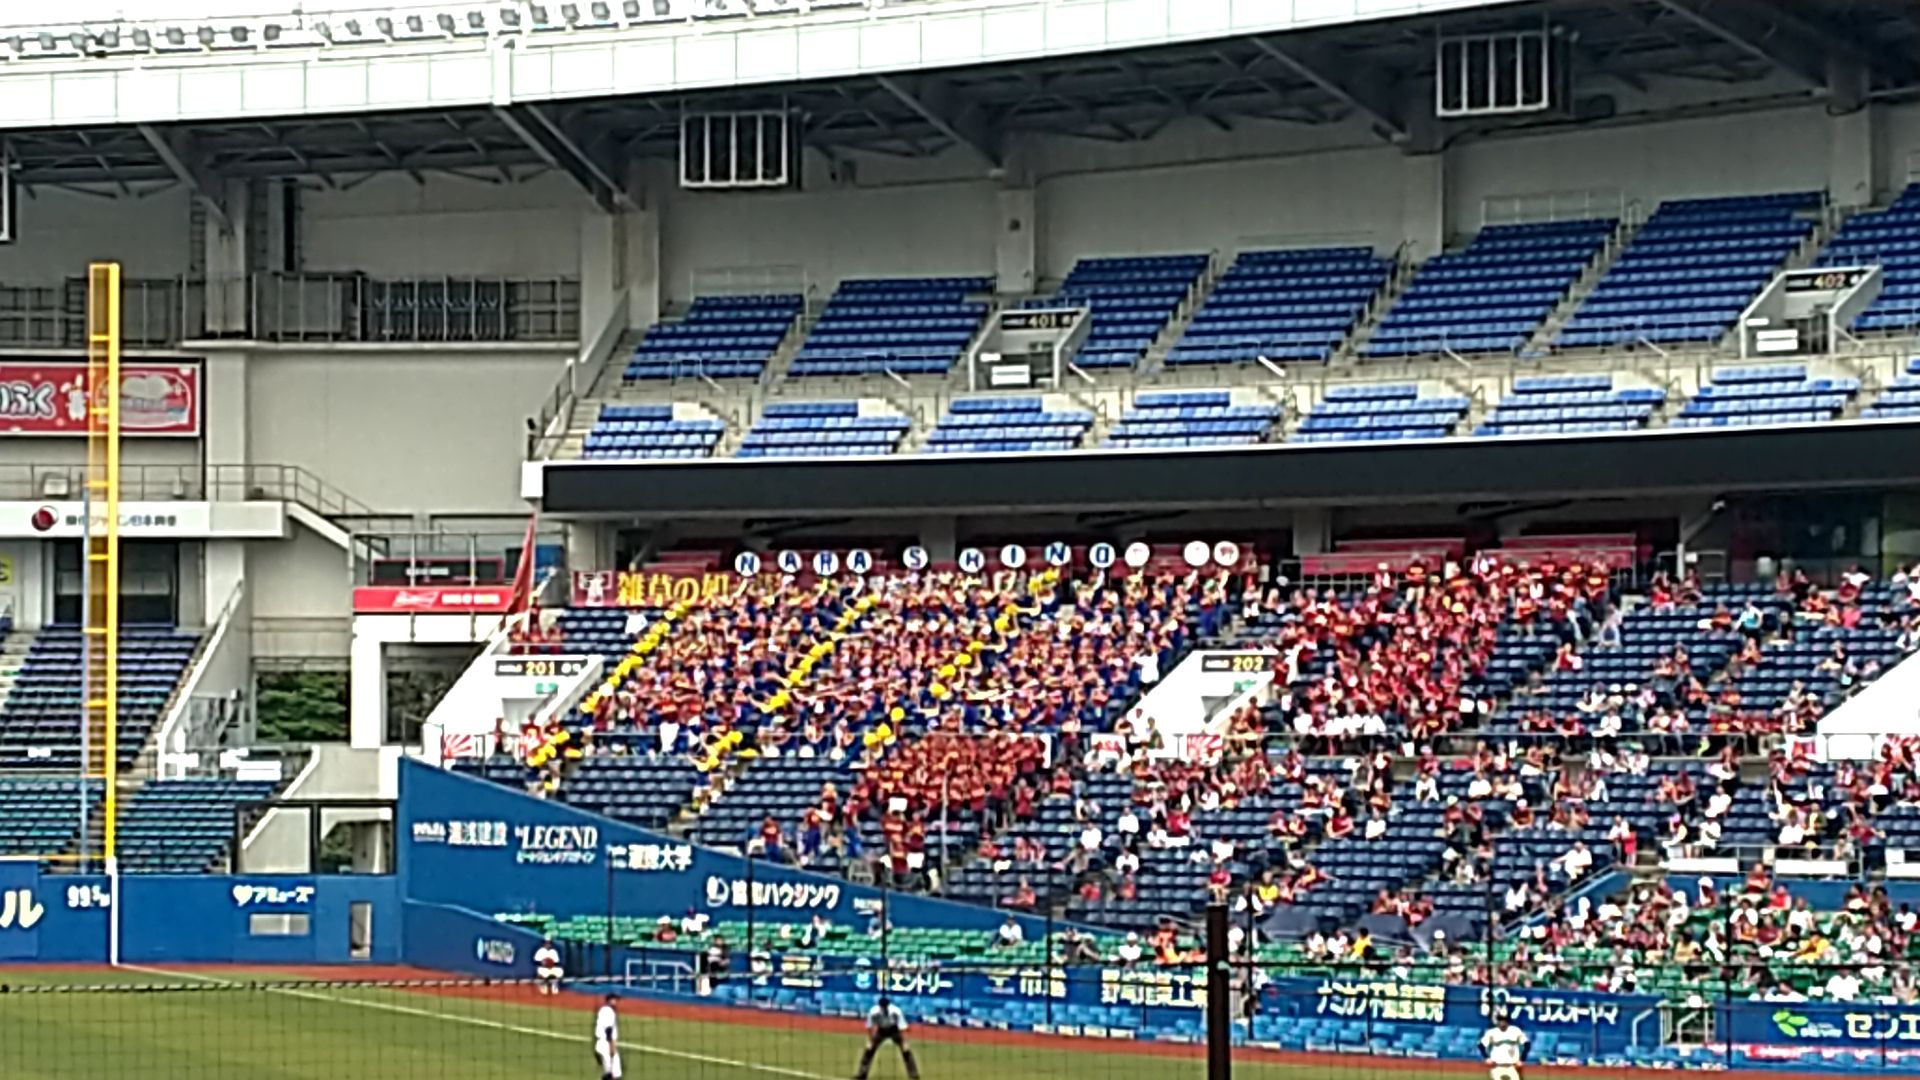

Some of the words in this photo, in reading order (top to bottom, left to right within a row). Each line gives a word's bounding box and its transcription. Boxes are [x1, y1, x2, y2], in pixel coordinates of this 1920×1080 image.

[1814, 275, 1845, 289] 402
[1028, 315, 1056, 328] 401
[616, 572, 748, 607] 雑草の如
[526, 662, 555, 676] 201
[1233, 657, 1264, 671] 202
[522, 825, 597, 849] LEGEND
